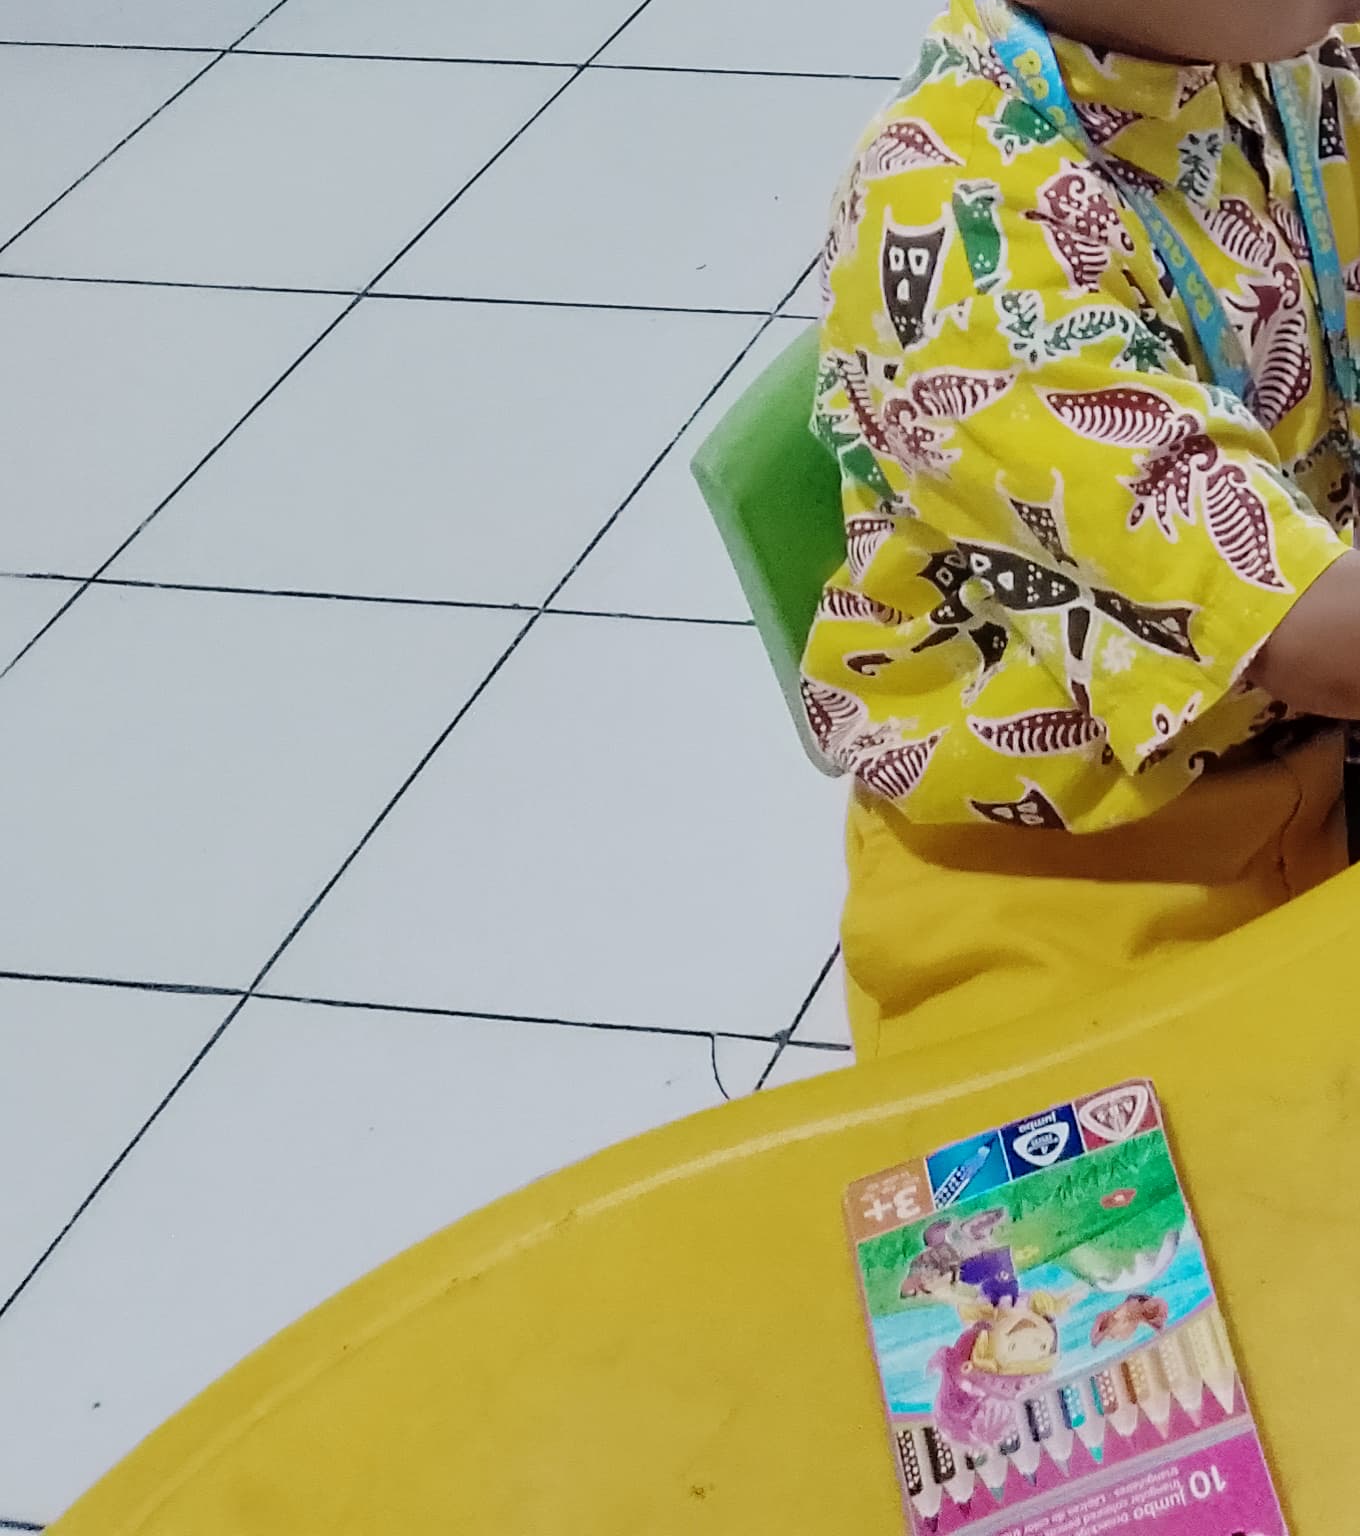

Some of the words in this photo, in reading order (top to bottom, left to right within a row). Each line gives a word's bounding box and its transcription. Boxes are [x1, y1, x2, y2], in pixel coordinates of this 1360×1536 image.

[1012, 50, 1050, 99] RA
[1185, 273, 1213, 321] RA
[1018, 1112, 1057, 1133] jumbo
[863, 1185, 921, 1222] 3+
[1189, 1464, 1226, 1499] 10
[1133, 1492, 1186, 1520] jumbo
